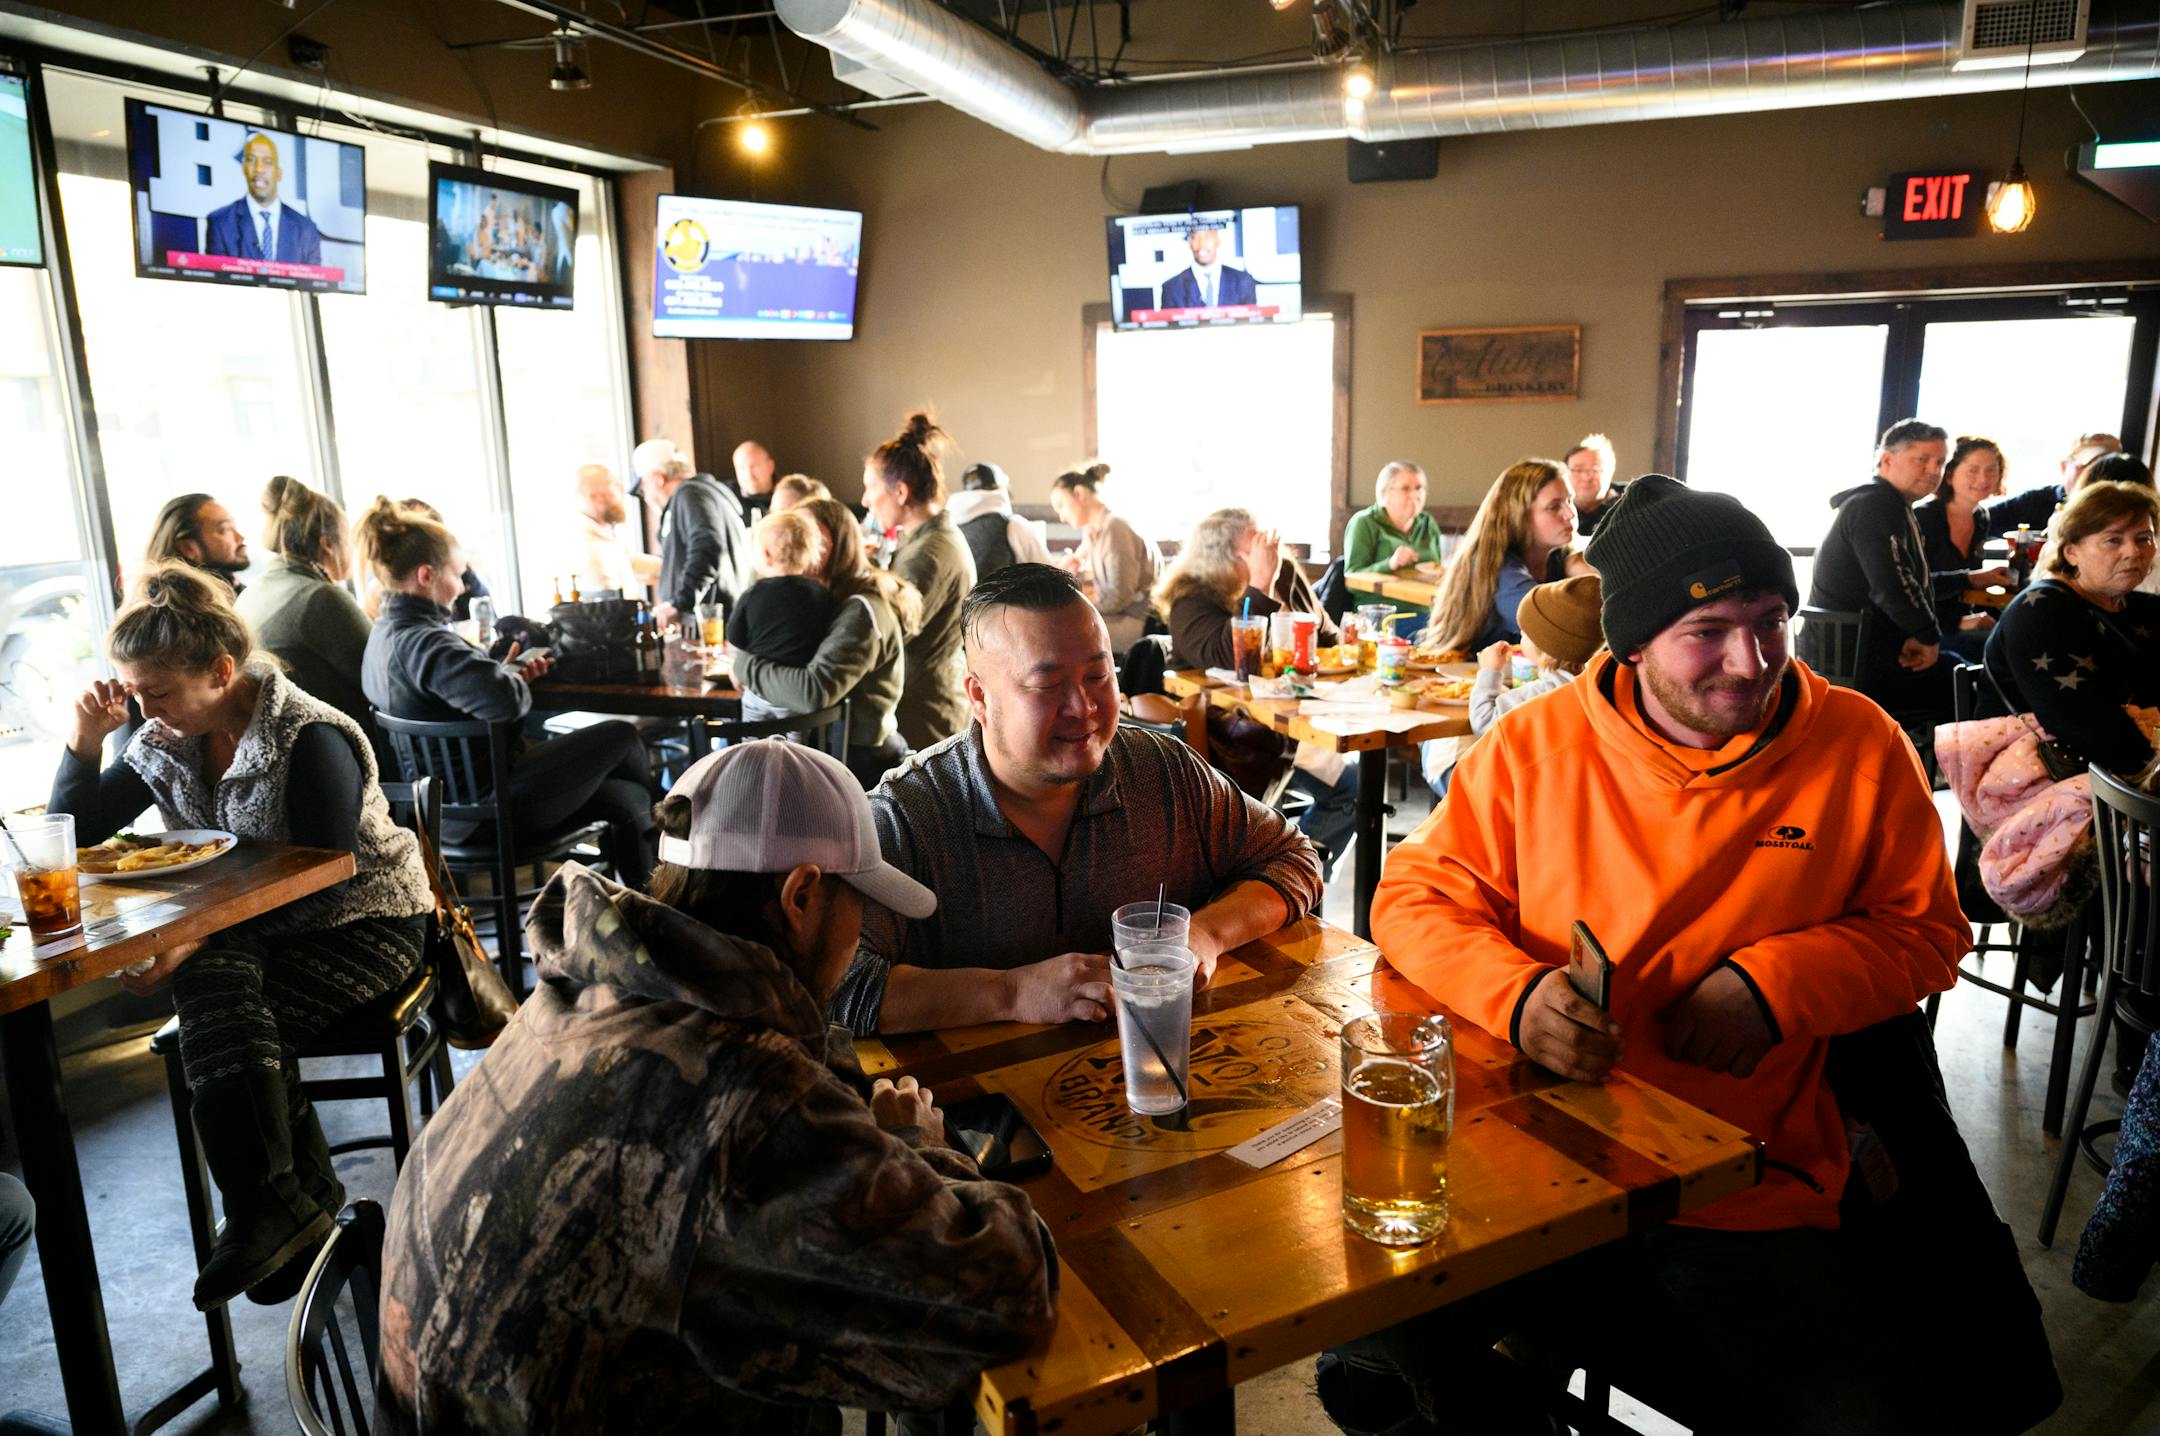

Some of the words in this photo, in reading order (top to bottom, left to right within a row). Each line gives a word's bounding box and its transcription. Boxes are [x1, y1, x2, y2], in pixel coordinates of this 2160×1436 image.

[1903, 173, 1970, 222] EXIT
[1754, 840, 1791, 849] MOSSY
[1791, 842, 1812, 850] OAK
[1058, 1074, 1147, 1138] BRAND
